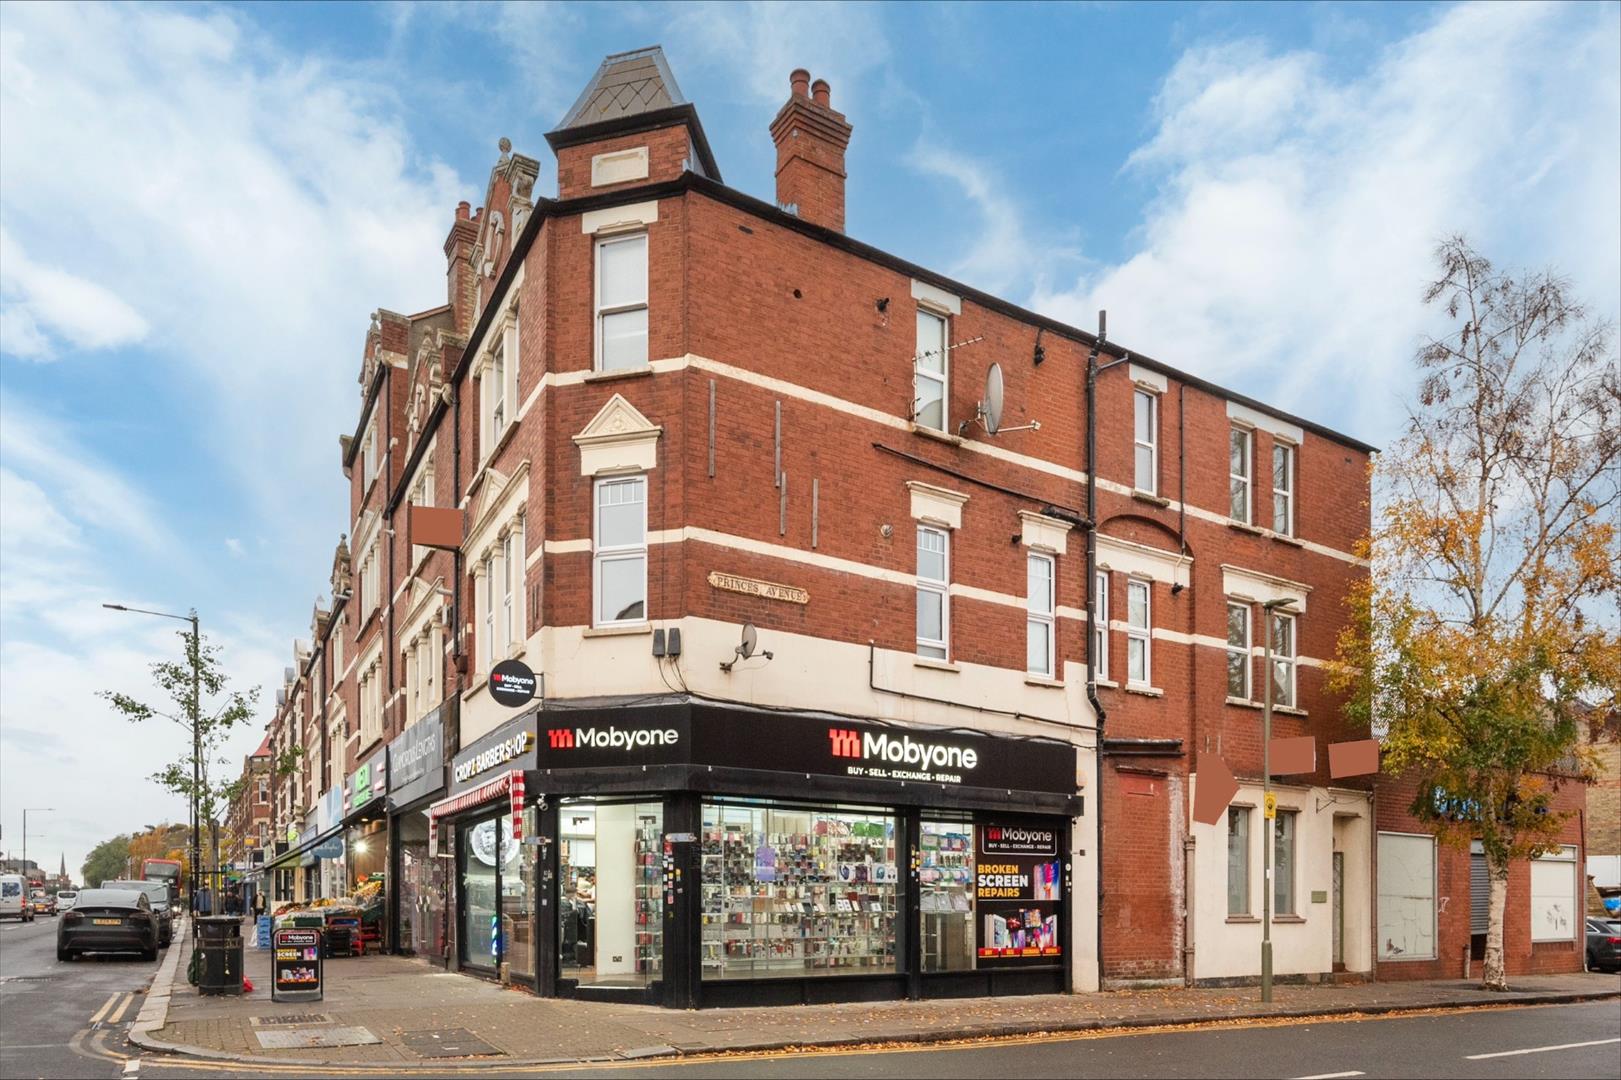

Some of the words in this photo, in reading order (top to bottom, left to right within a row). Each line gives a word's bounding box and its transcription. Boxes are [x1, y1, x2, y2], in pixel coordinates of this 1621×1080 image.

[717, 576, 759, 593] PRINCES
[765, 585, 804, 601] AVENUE
[575, 726, 679, 750] Mobyone
[863, 731, 978, 771] Mobyone
[847, 766, 864, 775] BUY
[869, 768, 887, 777] SELL
[892, 770, 931, 781] EXCHANGE
[936, 773, 961, 783] REPAIR
[1002, 827, 1052, 844] Mobyone
[977, 864, 1018, 874] BROKEN
[978, 875, 1028, 887] SCREEN
[978, 887, 1020, 897] REPAIRS
